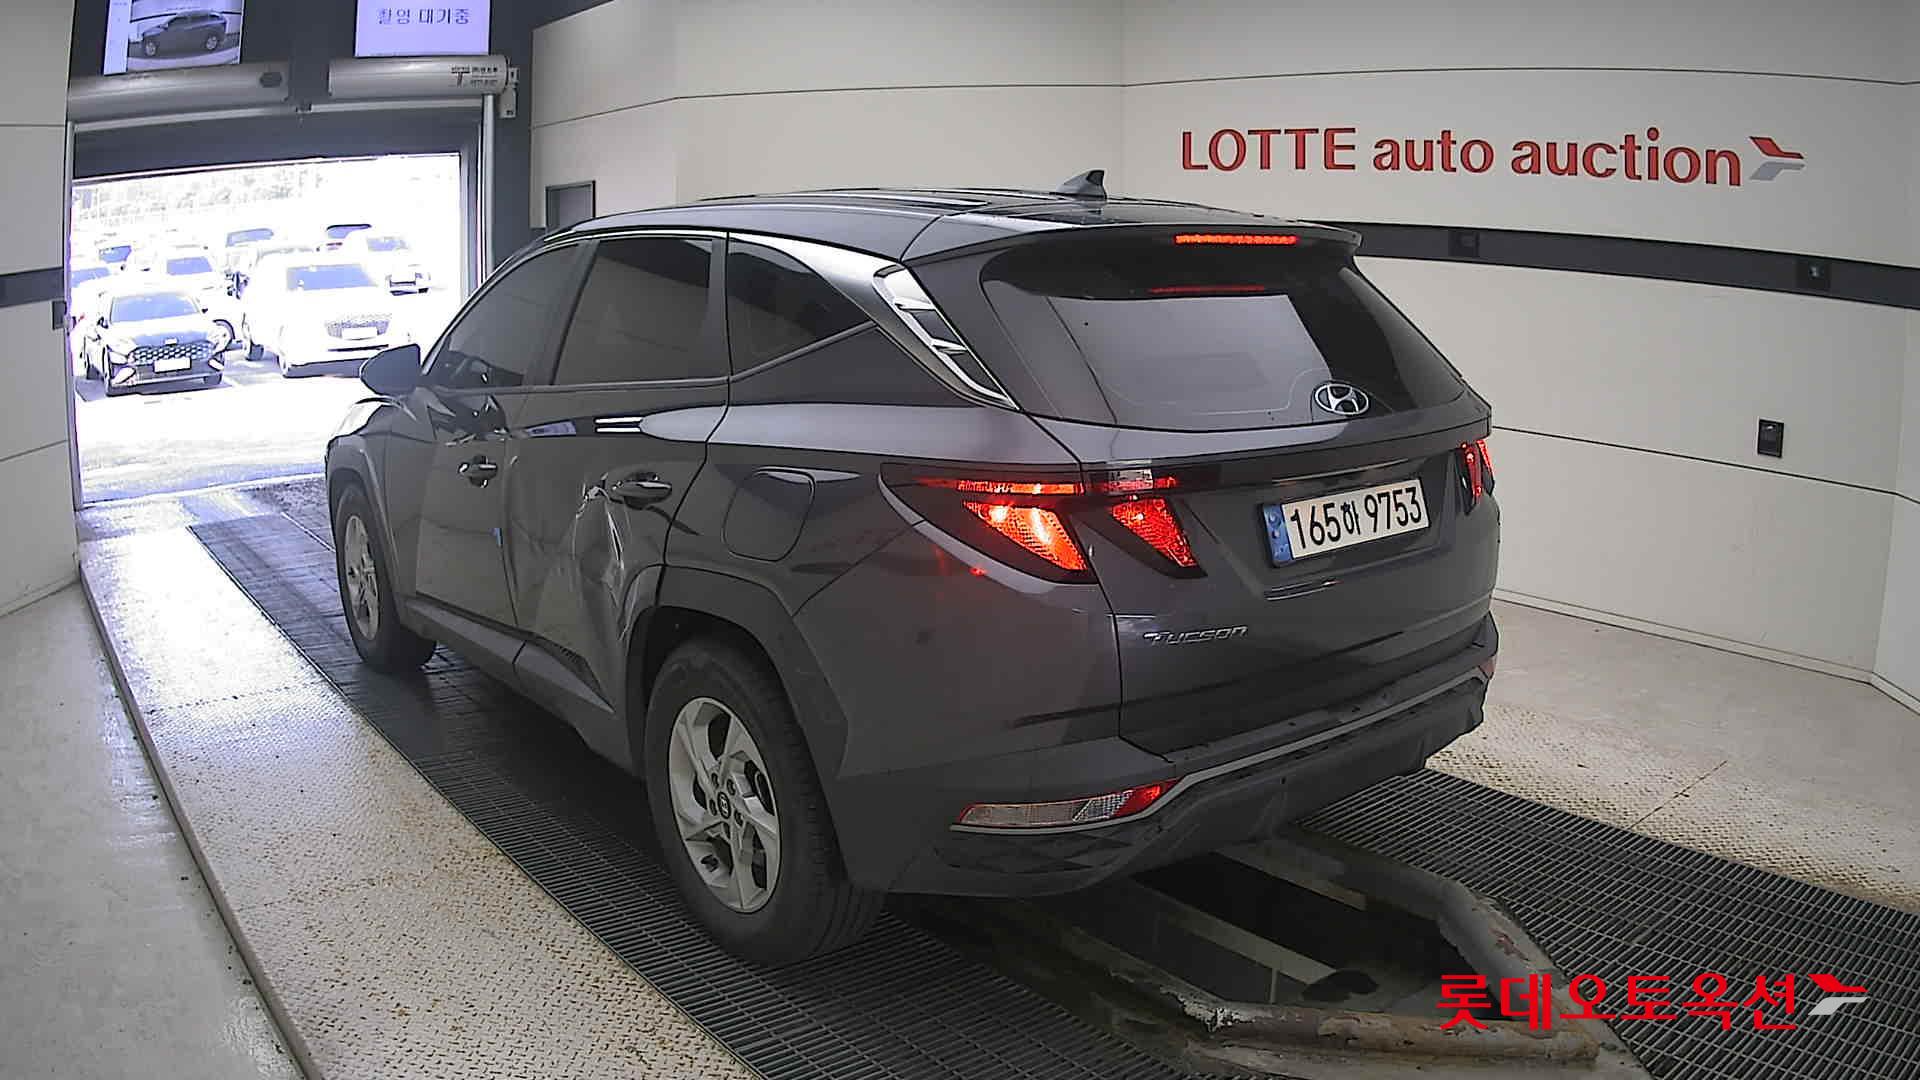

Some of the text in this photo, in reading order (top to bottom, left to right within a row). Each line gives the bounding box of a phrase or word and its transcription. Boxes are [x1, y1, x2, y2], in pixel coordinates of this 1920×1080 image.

[418, 8, 470, 25] 대기중
[1182, 127, 1741, 187] LOTTE auto auction
[1290, 486, 1422, 550] 165하 9753
